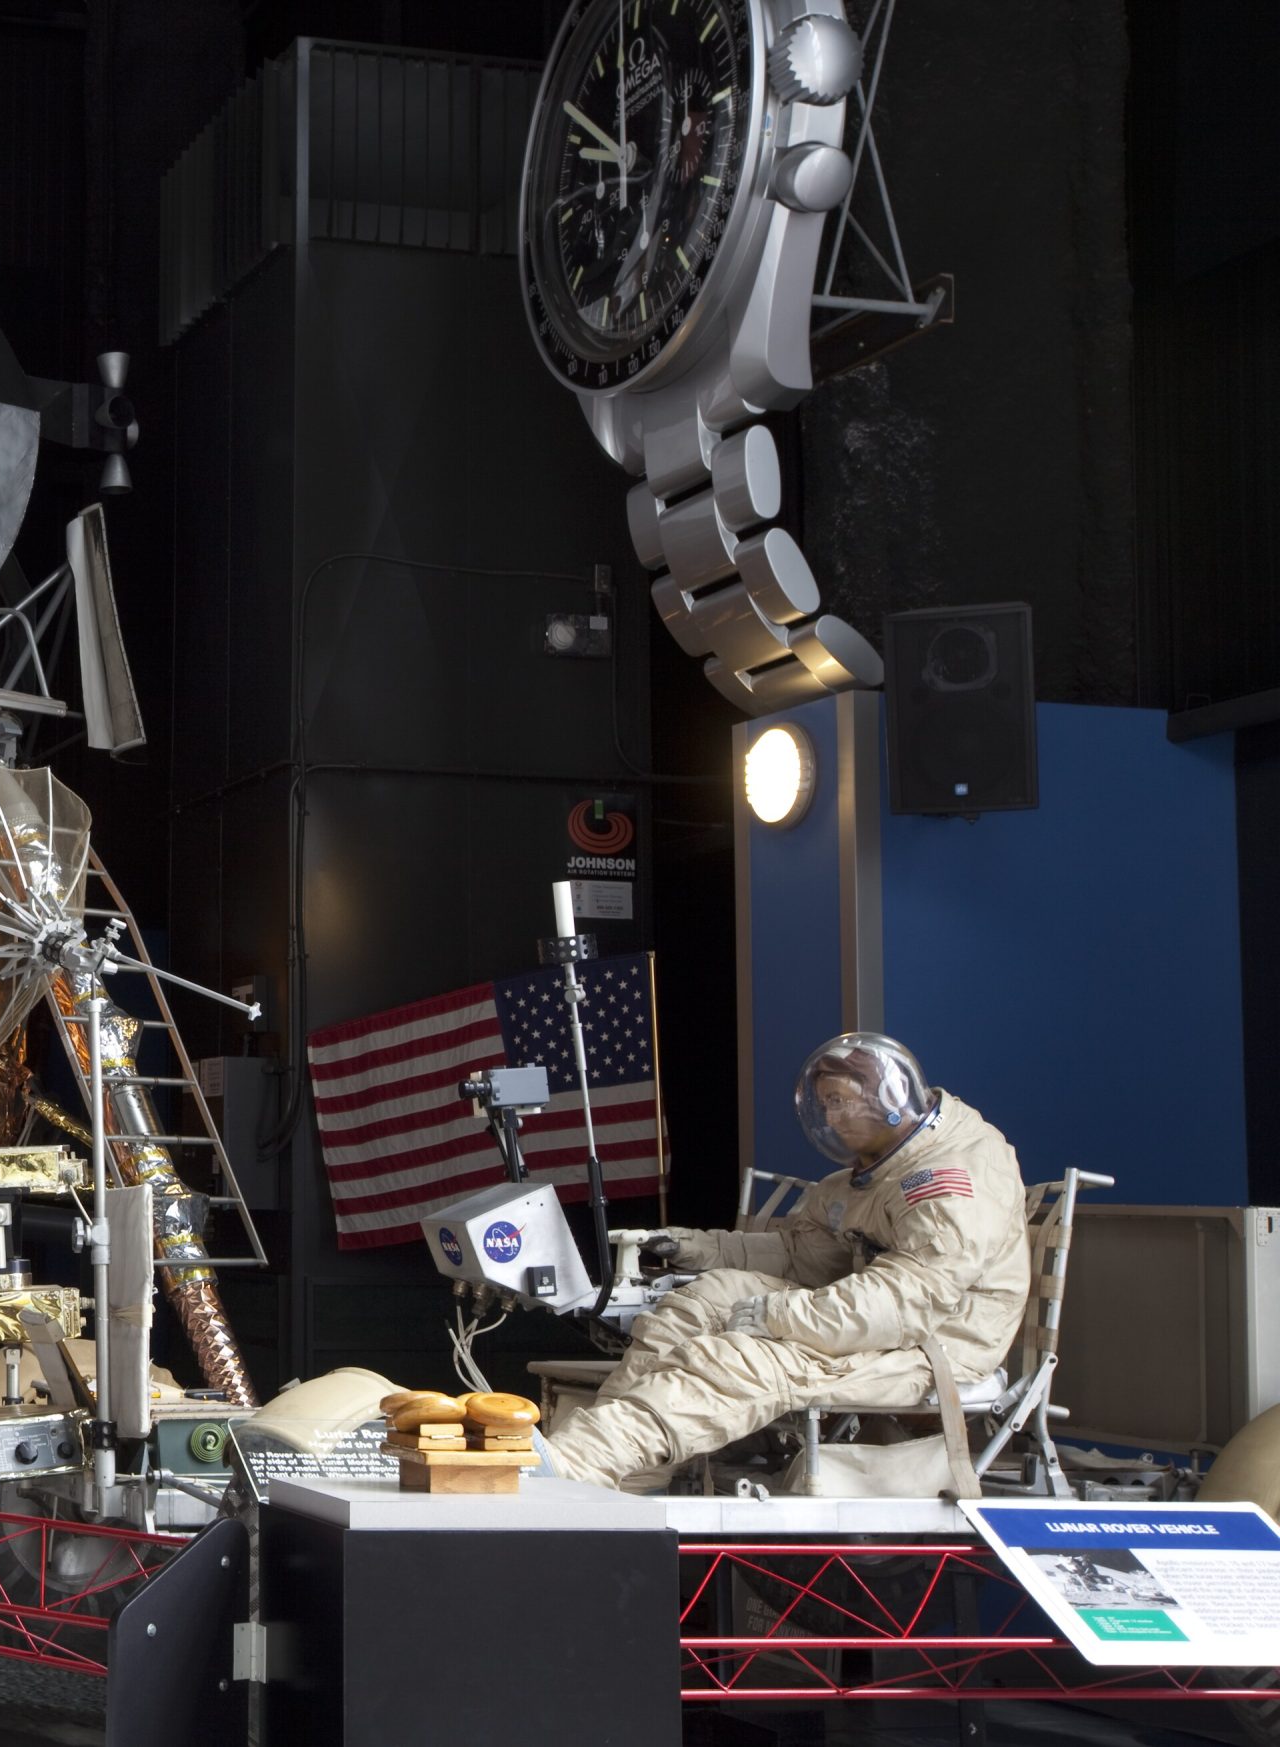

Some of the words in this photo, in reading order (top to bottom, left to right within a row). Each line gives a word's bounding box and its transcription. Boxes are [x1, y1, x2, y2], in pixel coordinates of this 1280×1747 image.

[695, 121, 706, 136] 10
[669, 140, 681, 158] 20
[582, 209, 593, 224] 40
[662, 219, 670, 232] 3
[713, 220, 725, 238] 170
[622, 248, 628, 261] 9
[705, 242, 717, 260] 160
[642, 272, 648, 284] 6
[690, 277, 701, 296] 150
[671, 308, 684, 327] 140
[649, 339, 661, 358] 130
[567, 359, 578, 377] 100
[628, 360, 639, 376] 120
[598, 369, 608, 386] 110
[567, 856, 636, 871] JOHNSON
[442, 1242, 460, 1253] NASA
[486, 1237, 519, 1248] NASA
[314, 1429, 357, 1440] Lunar
[360, 1429, 388, 1439] Rov
[336, 1441, 352, 1449] did
[354, 1441, 373, 1449] the
[316, 1452, 357, 1460] designed
[1045, 1522, 1101, 1533] LUNAR
[1099, 1523, 1155, 1534] ROVER
[1152, 1524, 1220, 1535] VEHICLE
